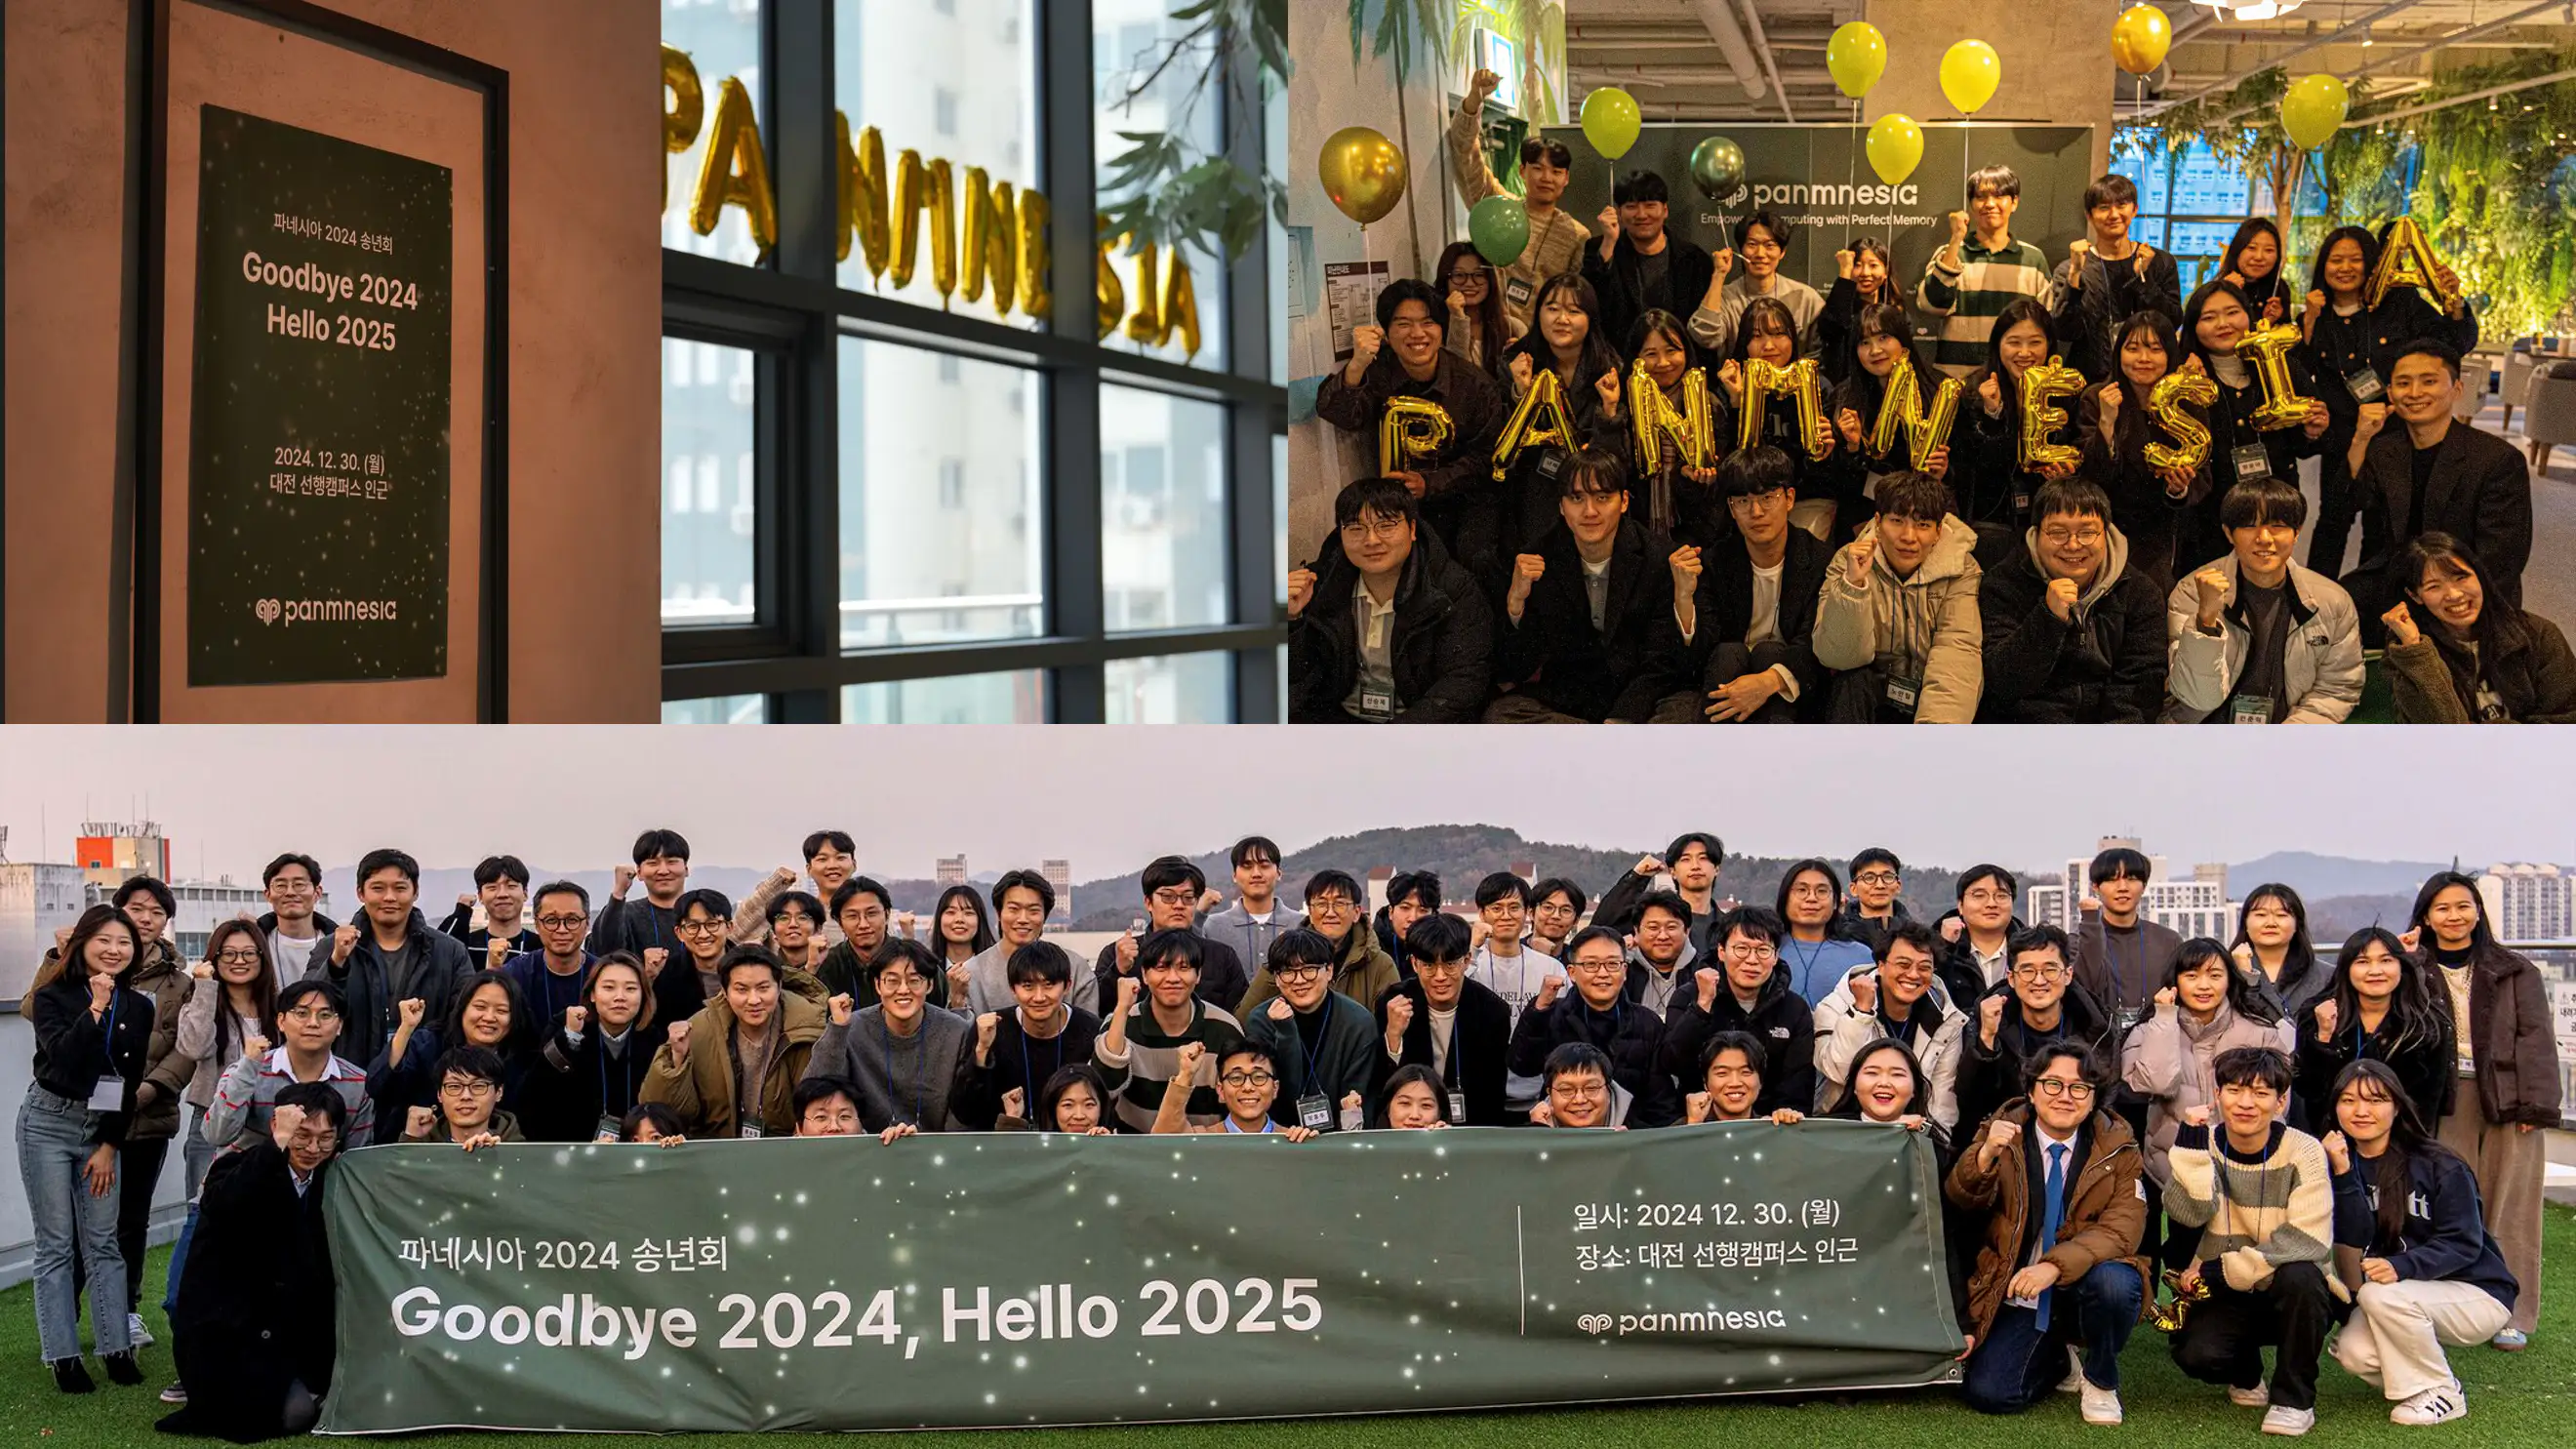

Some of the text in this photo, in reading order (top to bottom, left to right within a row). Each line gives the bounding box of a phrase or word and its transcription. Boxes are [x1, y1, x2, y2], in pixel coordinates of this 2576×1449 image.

[1753, 183, 1918, 210] panmnesia
[273, 213, 393, 255] 파네시아 2024 송년회
[1826, 214, 1849, 224] with
[1852, 214, 1890, 225] Perfect
[1893, 215, 1938, 227] Memory
[242, 251, 418, 310] Goodbye 2024
[266, 302, 396, 351] Hello 2025
[274, 447, 385, 476] 2024. 12. 30. (월)
[269, 472, 388, 501] 대전 선행캠퍼스 인근
[285, 598, 397, 627] panmnesia
[1574, 1198, 1841, 1230] 일시: 2024 12. 30. (월)
[398, 1235, 728, 1272] 파네시아 2024 송년회
[1576, 1237, 1859, 1271] 장소: 대전 선행캠퍼스 인근
[390, 1277, 1323, 1361] Goodbye 2024, Hello 2025
[1619, 1307, 1788, 1337] panmnesia
